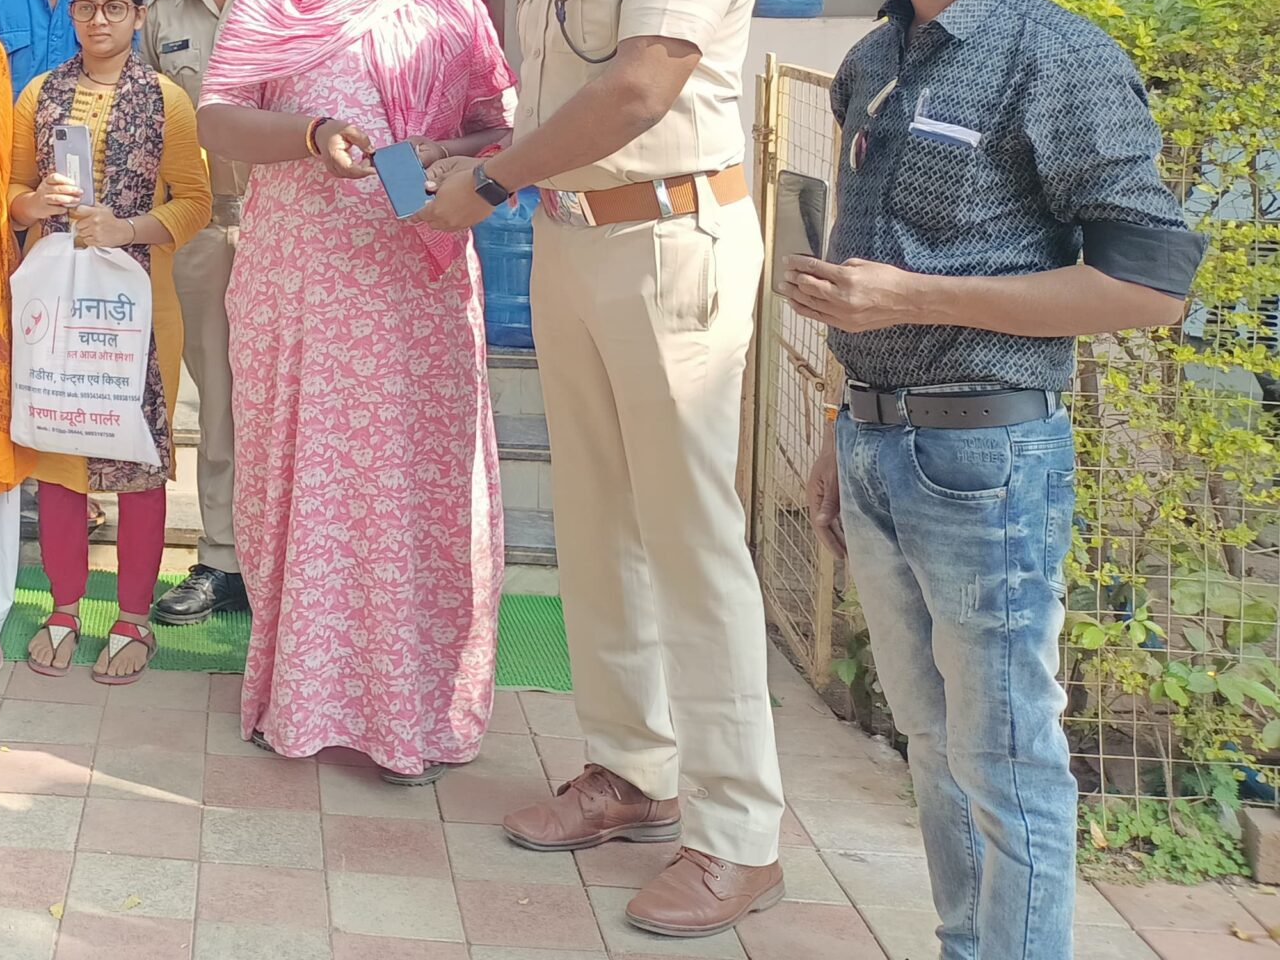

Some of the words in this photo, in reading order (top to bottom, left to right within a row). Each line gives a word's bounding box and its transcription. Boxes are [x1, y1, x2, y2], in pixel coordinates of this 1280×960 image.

[78, 331, 119, 348] चप्पल
[28, 402, 57, 421] प्रेरणा
[90, 409, 121, 427] पार्लर
